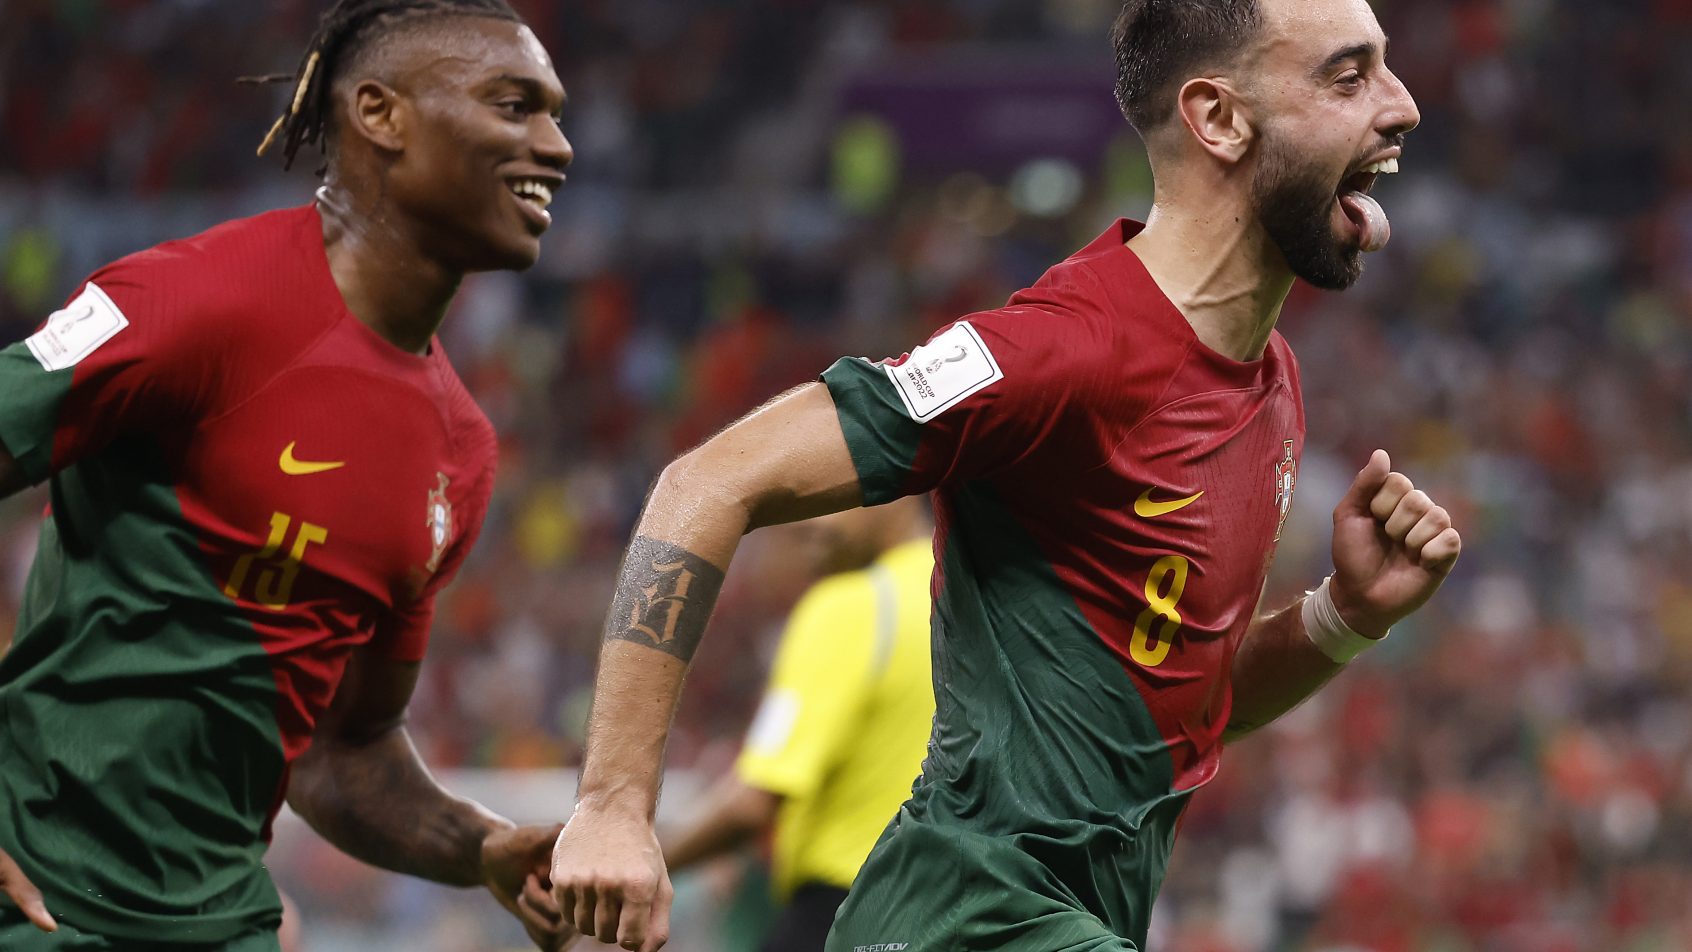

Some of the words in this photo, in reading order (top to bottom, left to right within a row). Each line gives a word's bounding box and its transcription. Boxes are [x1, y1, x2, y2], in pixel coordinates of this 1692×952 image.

[925, 385, 936, 398] CUP
[224, 511, 328, 611] 15
[1129, 555, 1189, 667] 8
